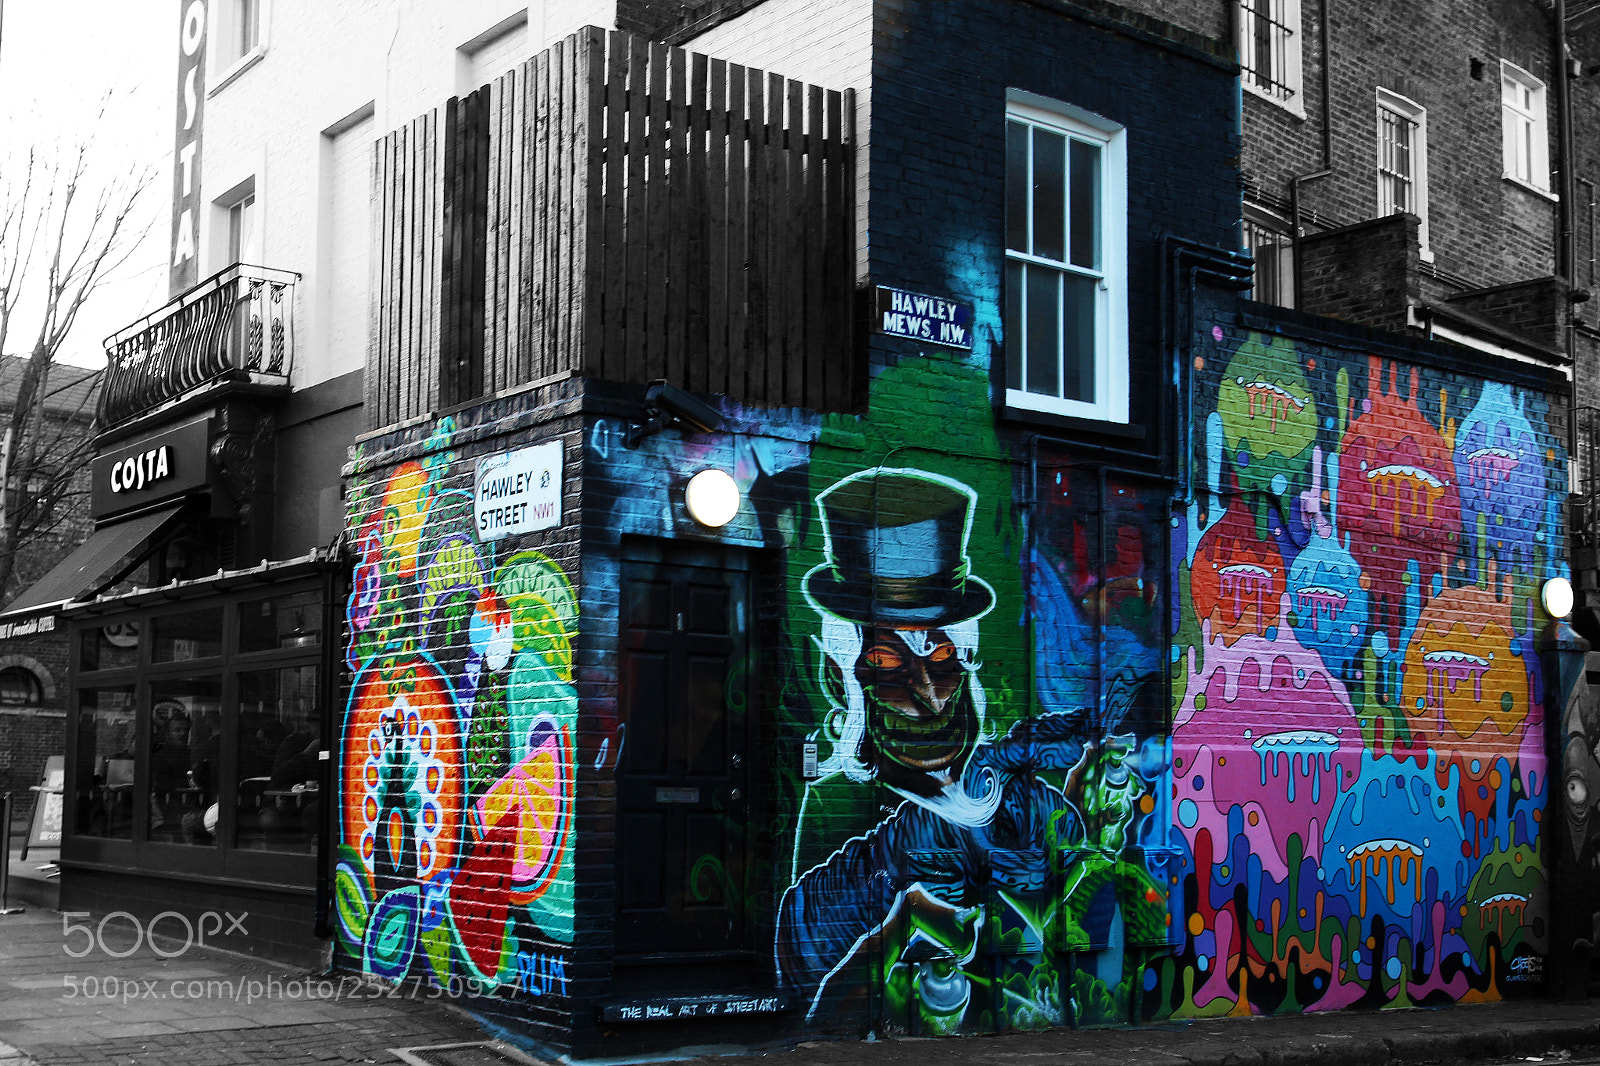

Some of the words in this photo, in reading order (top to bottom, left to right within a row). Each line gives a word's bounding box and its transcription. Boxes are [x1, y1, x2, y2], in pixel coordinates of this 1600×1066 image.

[891, 291, 957, 322] HAWLEY
[110, 445, 169, 493] COSTA
[481, 470, 533, 501] HAWLEY
[480, 502, 528, 530] STREET
[533, 501, 554, 520] NW1
[620, 1006, 642, 1019] THE
[646, 1004, 673, 1018] REAL
